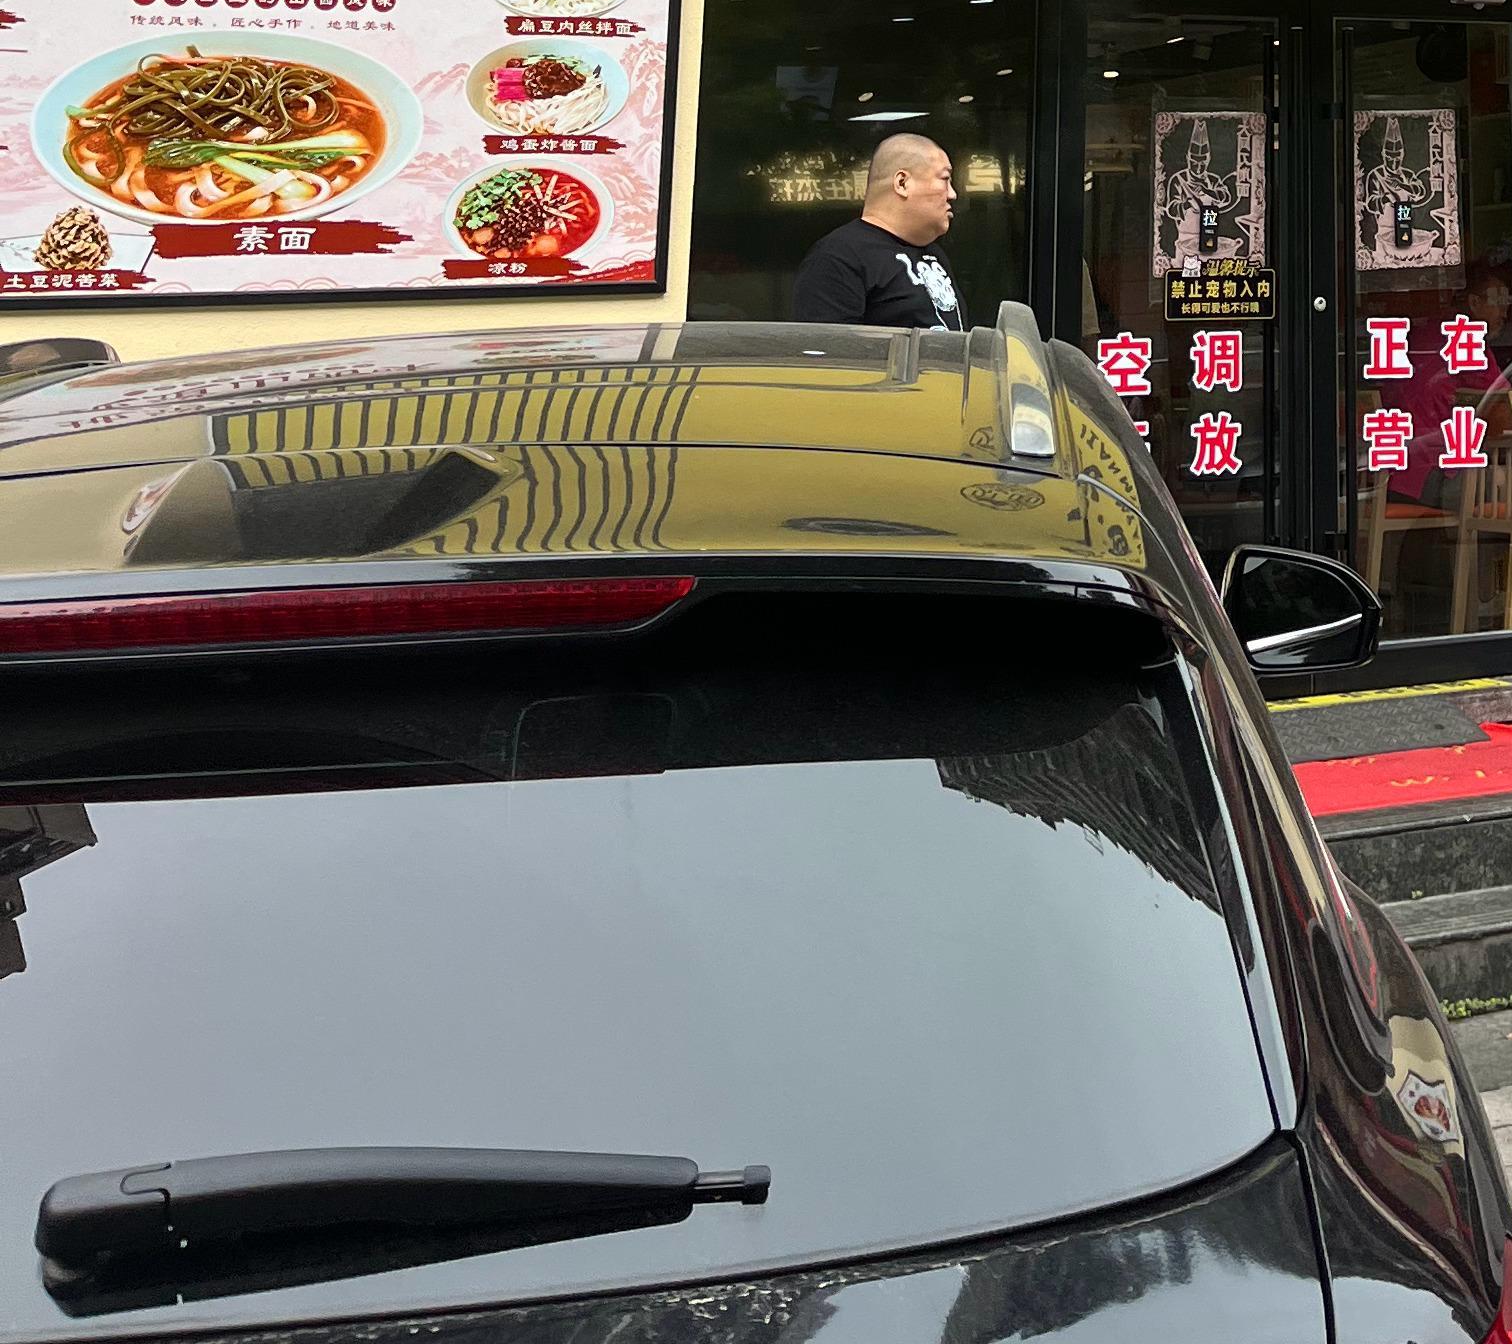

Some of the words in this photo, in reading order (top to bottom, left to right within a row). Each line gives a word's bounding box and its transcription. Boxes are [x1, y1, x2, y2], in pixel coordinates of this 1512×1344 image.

[501, 137, 598, 152] 鸡蛋炸酱面
[1202, 209, 1218, 227] 拉
[1397, 204, 1412, 221] 拉
[232, 226, 318, 252] 素面
[1206, 257, 1261, 278] 温馨提示
[1170, 279, 1271, 300] 禁止宠物入内
[1362, 314, 1490, 381] 正在
[1096, 330, 1244, 397] 空调
[1362, 408, 1490, 473] 营业
